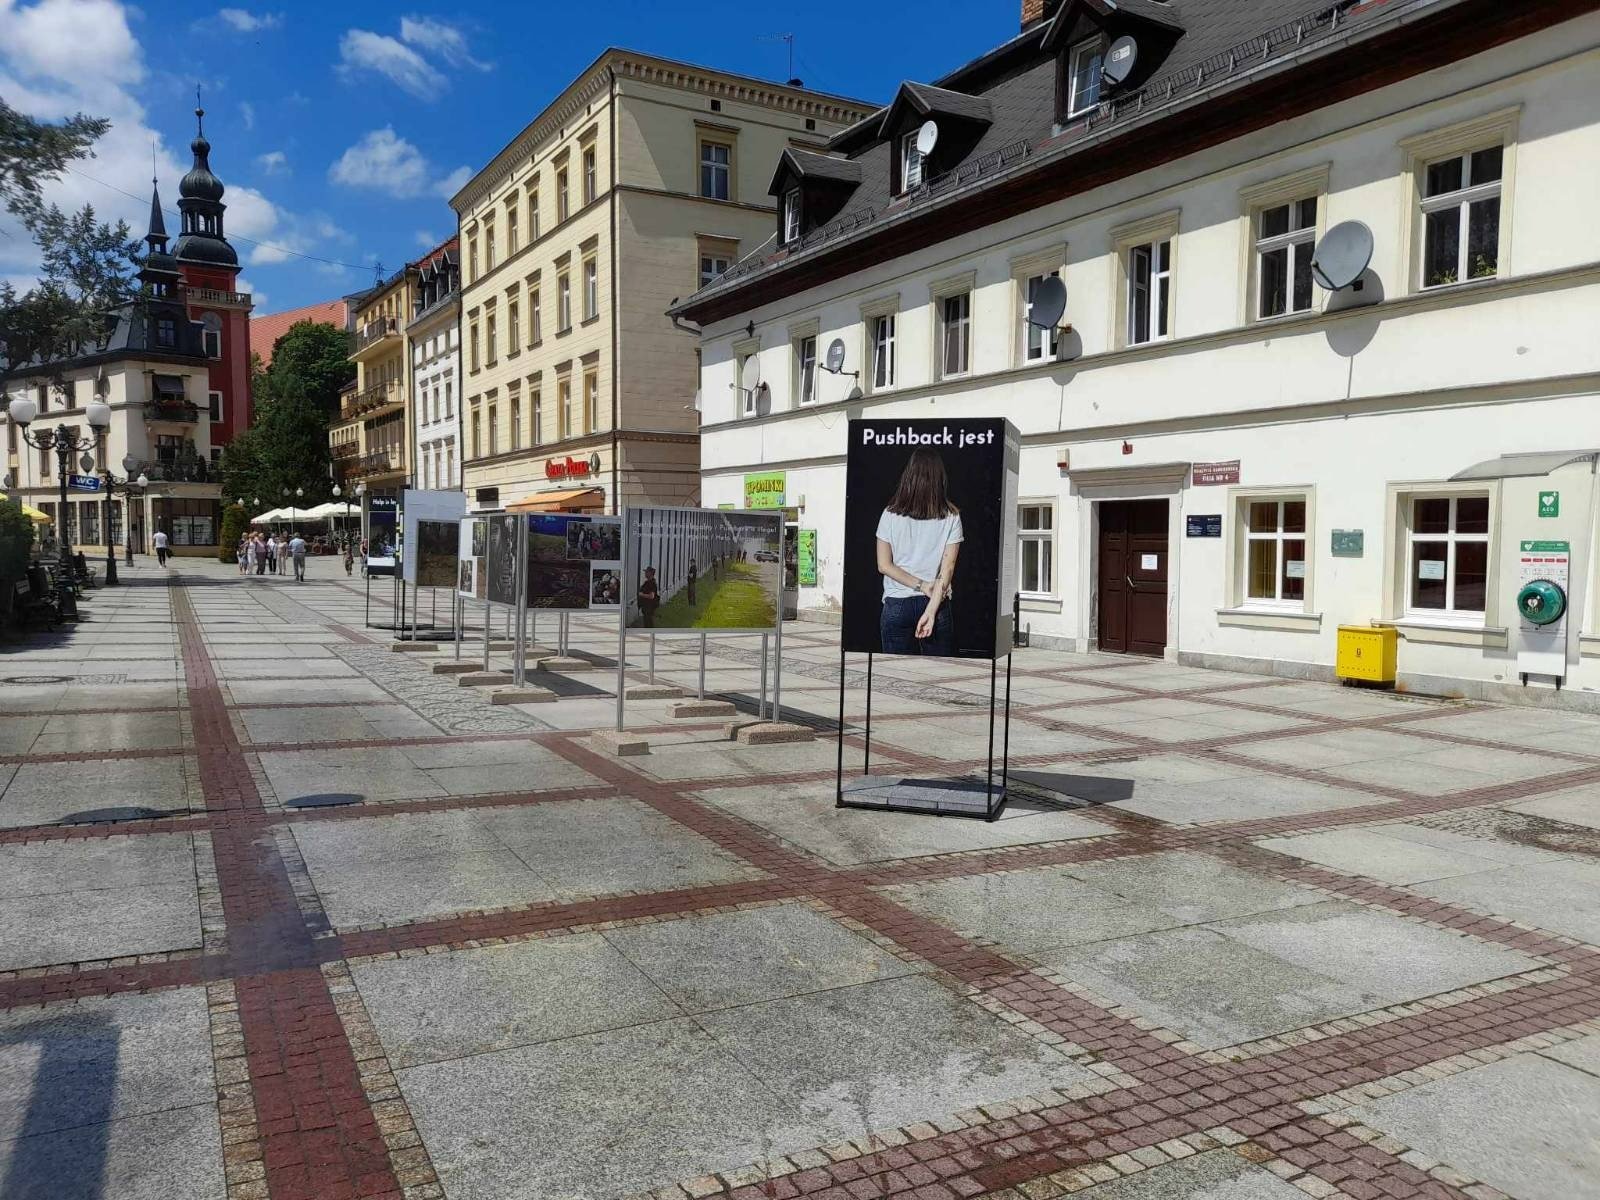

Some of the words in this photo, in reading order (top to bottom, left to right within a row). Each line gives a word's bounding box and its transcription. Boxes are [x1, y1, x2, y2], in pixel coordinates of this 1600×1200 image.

[862, 426, 953, 446] Pushback
[958, 429, 995, 449] jest
[76, 475, 95, 486] WC
